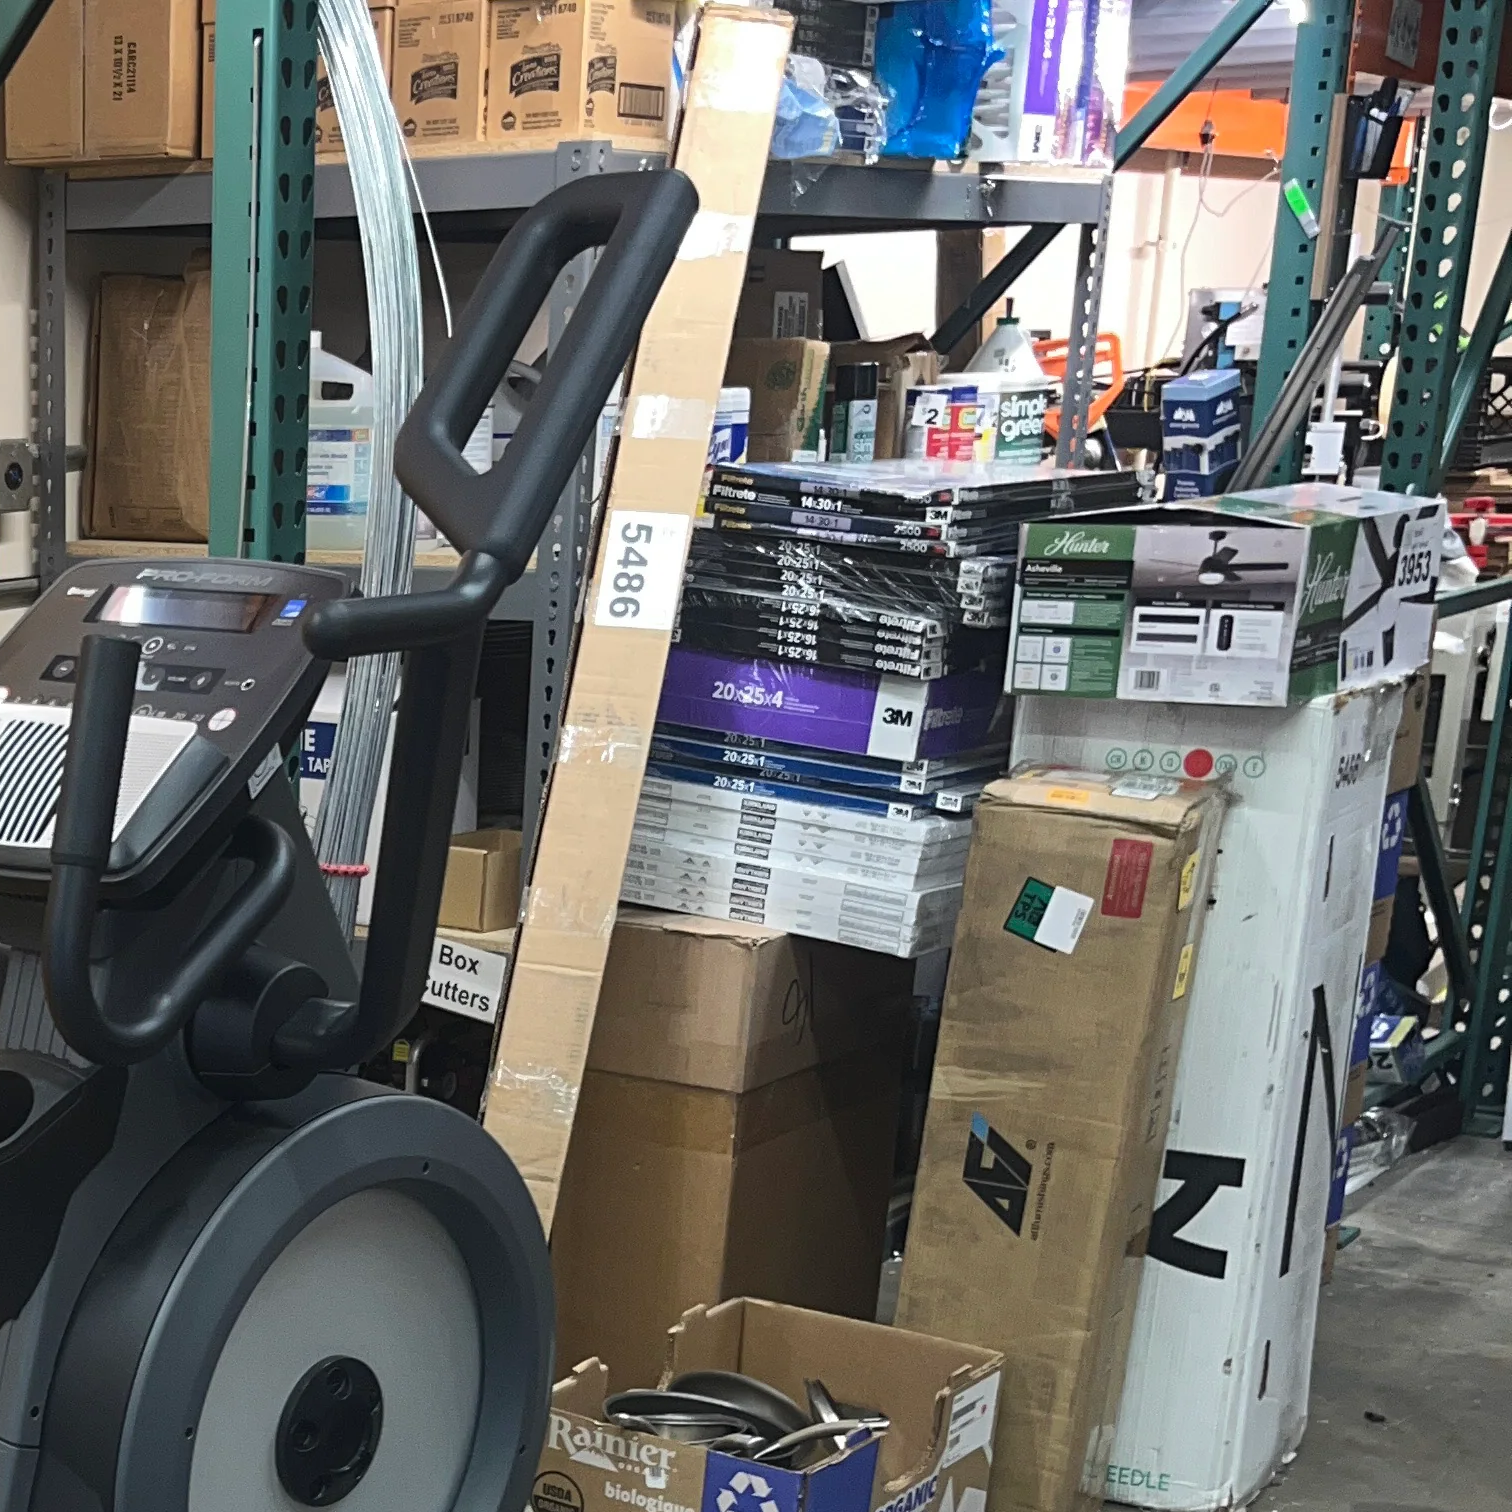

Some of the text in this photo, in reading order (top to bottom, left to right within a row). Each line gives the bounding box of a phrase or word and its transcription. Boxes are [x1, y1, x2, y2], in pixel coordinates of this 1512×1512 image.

[712, 484, 842, 512] Filtrete 14x30x1
[930, 510, 948, 520] 3M
[1044, 530, 1110, 556] Hunter
[136, 568, 274, 586] PRO-FORM
[609, 522, 653, 618] 5486
[1398, 550, 1432, 586] 3953
[878, 614, 926, 634] Filtrete
[777, 630, 816, 646] 16x25x1
[778, 645, 818, 661] 16x25x1
[874, 643, 920, 660] Filtrete
[875, 659, 920, 676] Filtrete
[712, 681, 784, 708] 20x25x4
[882, 708, 913, 727] 3M
[308, 755, 331, 774] TAP
[722, 750, 766, 767] 20x25x1
[714, 776, 755, 792] 20x25x1
[438, 944, 479, 976] Box
[548, 1413, 676, 1470] Rainier
[1106, 1464, 1171, 1492] EEDLE
[542, 1482, 572, 1502] USDA
